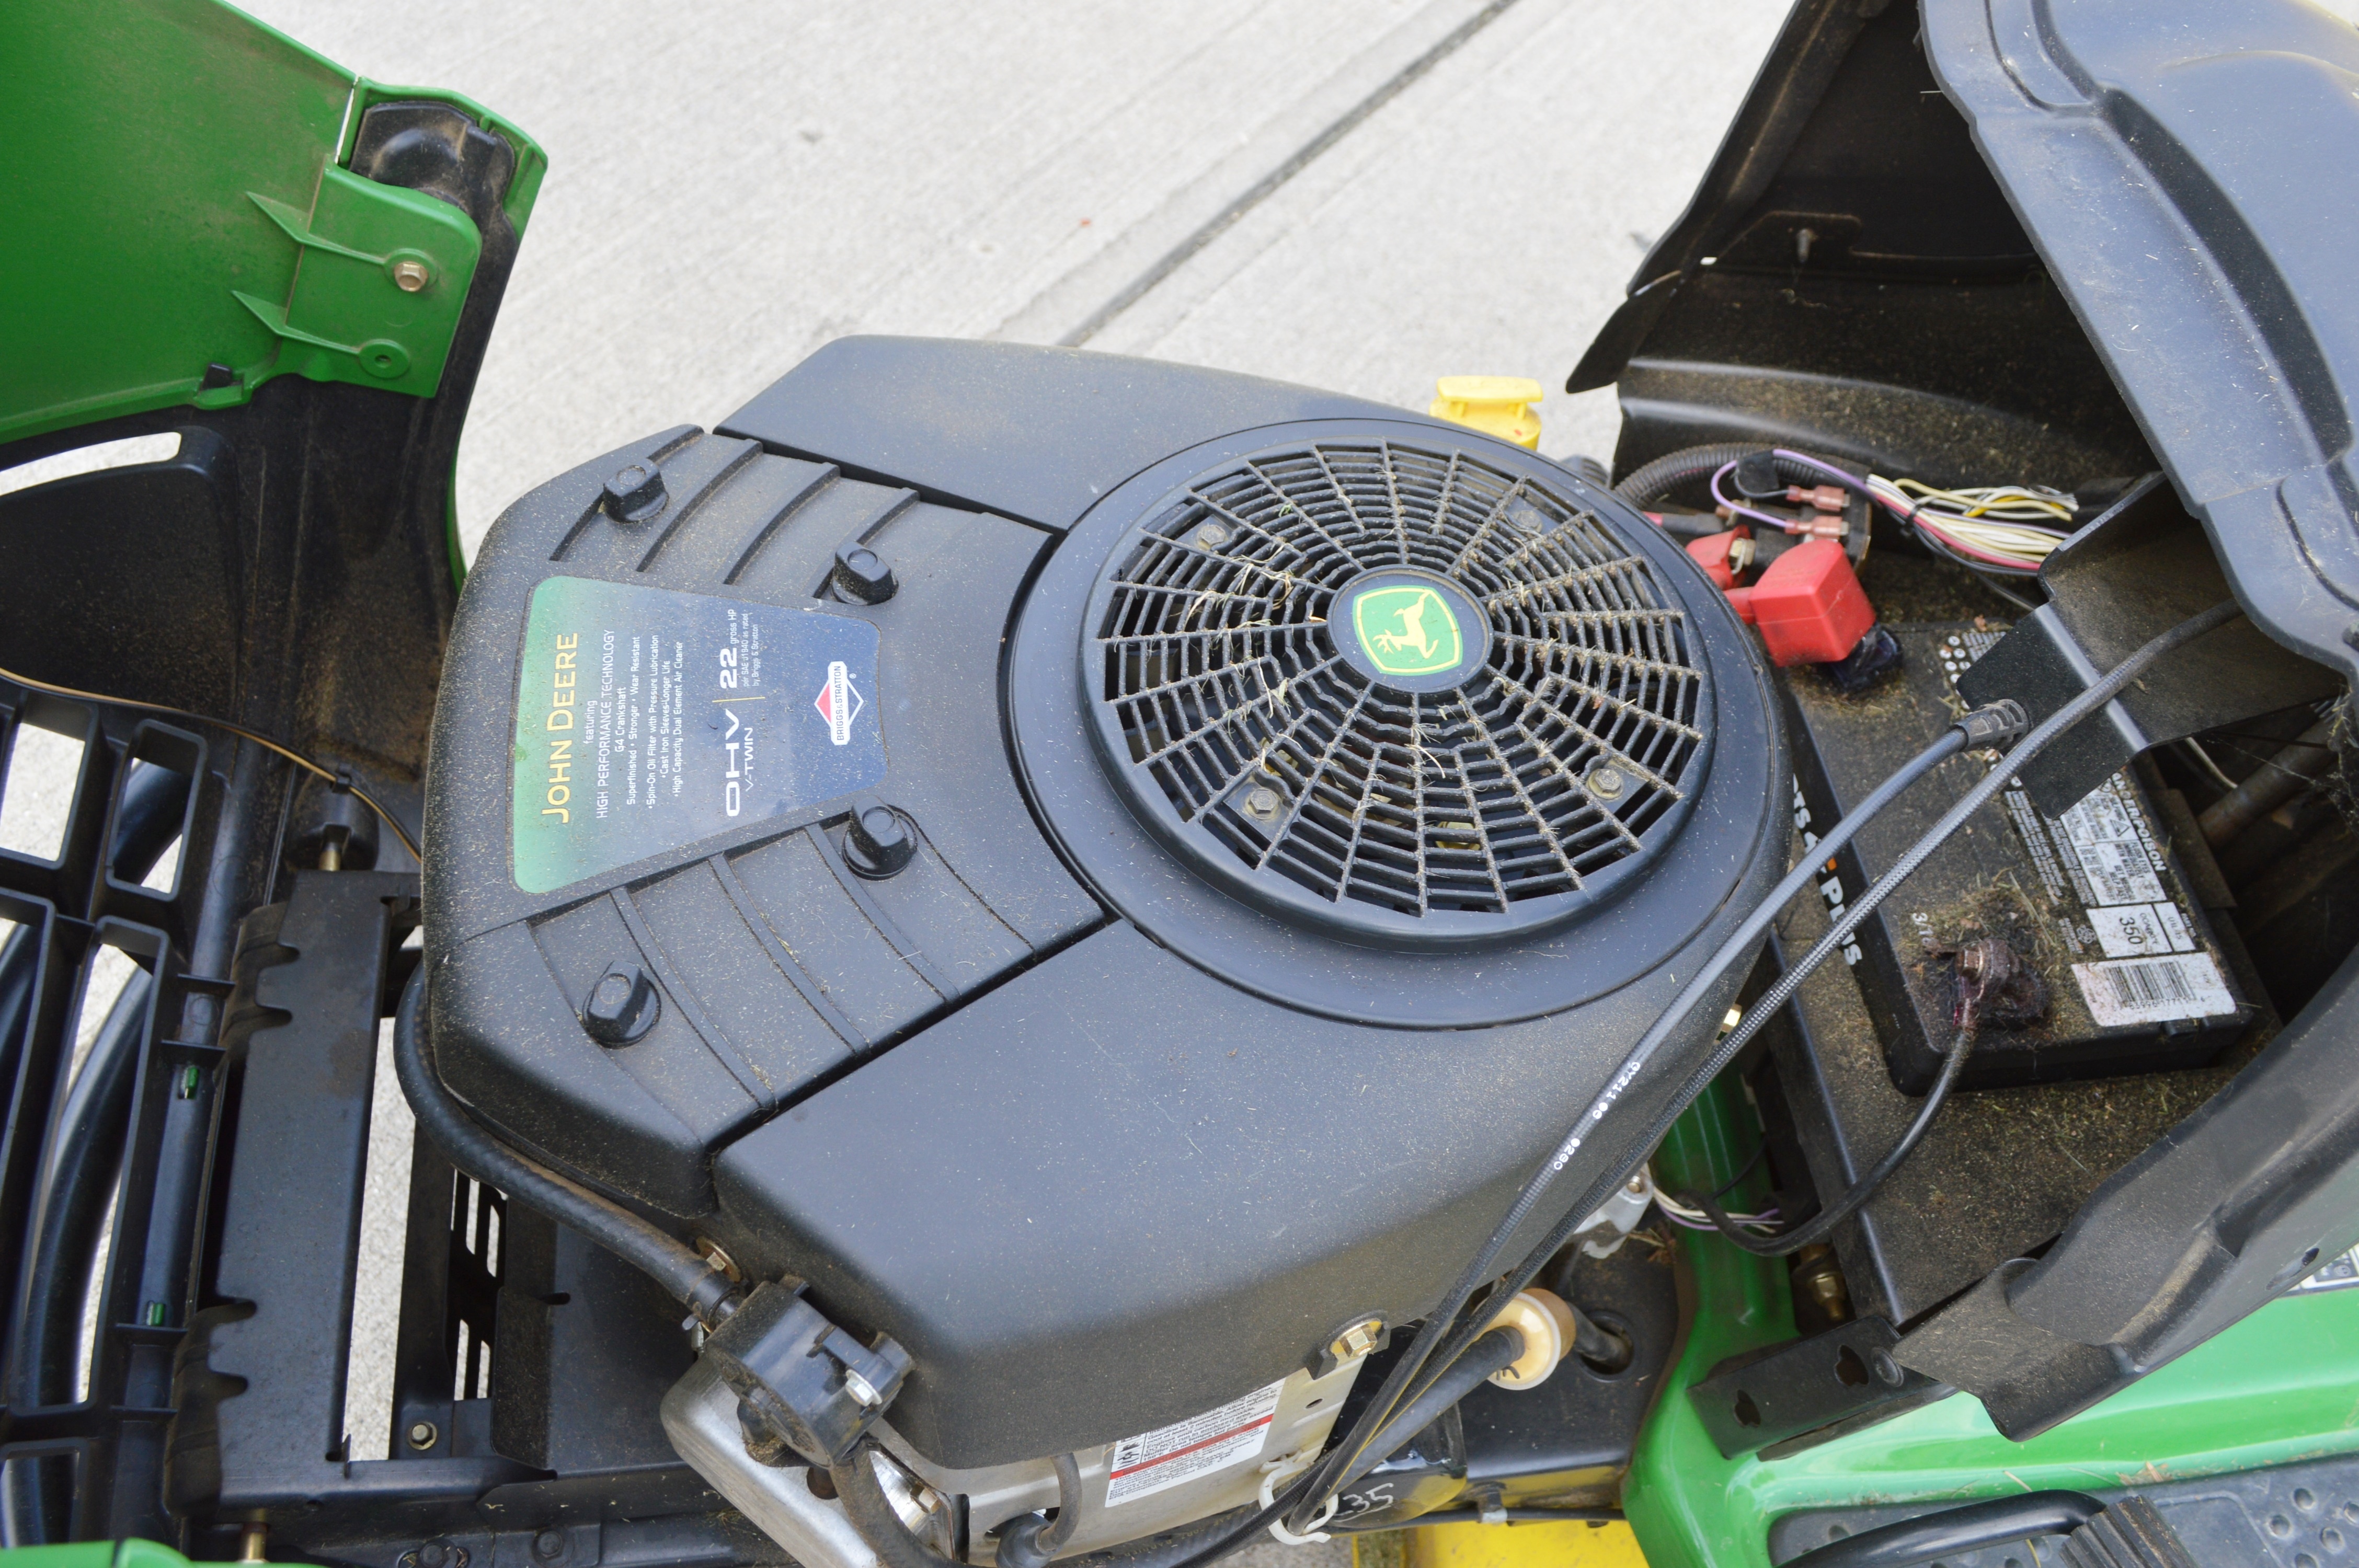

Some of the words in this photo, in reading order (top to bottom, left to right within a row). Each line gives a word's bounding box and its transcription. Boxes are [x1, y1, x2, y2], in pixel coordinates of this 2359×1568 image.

[727, 609, 737, 620] HP
[730, 622, 739, 644] gross
[601, 629, 614, 697] TECHNOLOGY
[631, 636, 640, 671] Resistant
[649, 635, 658, 675] Lubrication
[661, 660, 670, 673] Life
[719, 647, 737, 688] 22
[752, 658, 761, 677] Briggs
[546, 632, 578, 731] DEERE
[629, 674, 638, 695] Wear
[674, 671, 682, 682] Air
[648, 678, 657, 712] Pressure
[673, 685, 682, 714] Element
[583, 700, 597, 743] featuring
[615, 687, 626, 735] Crankshaft
[628, 705, 639, 739] Stronger
[647, 716, 657, 732] with
[673, 717, 682, 734] Dual
[597, 701, 612, 786] PERFORMANCE
[614, 738, 626, 752] G4
[647, 735, 656, 755] Filter
[660, 737, 669, 752] Iron
[672, 737, 683, 772] Capacity
[744, 727, 753, 791] V-TWIN
[626, 750, 637, 804] Superfinished
[647, 759, 656, 769] Oil
[725, 708, 740, 816] OHV
[541, 740, 572, 823] JOHN
[596, 791, 609, 818] HIGH
[2120, 917, 2143, 944] 350
